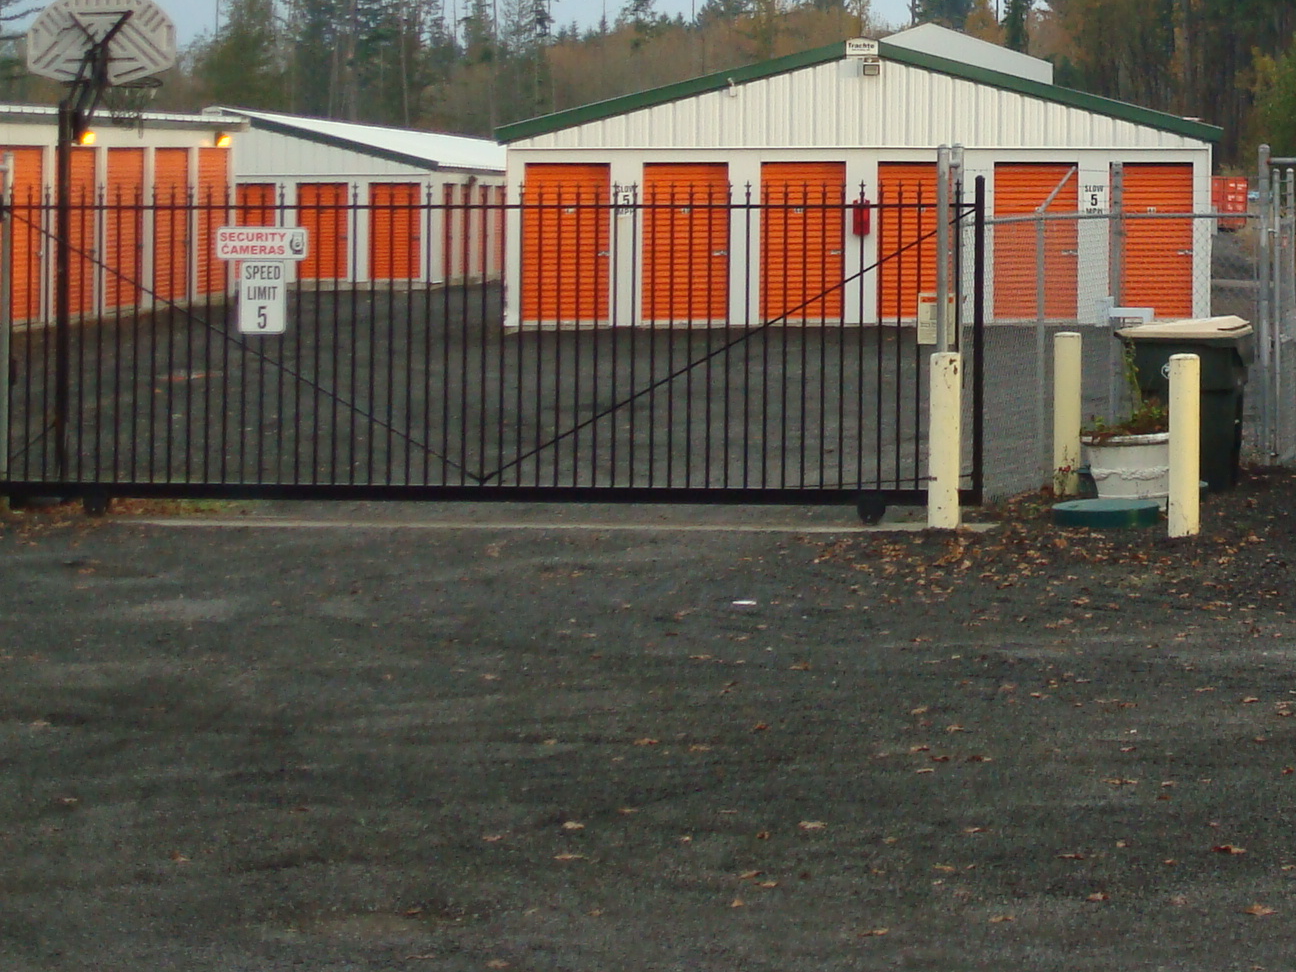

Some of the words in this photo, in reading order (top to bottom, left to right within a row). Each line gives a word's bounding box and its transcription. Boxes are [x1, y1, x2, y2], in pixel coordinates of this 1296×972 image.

[1085, 184, 1104, 192] SLOW
[623, 194, 630, 206] 5
[1090, 194, 1098, 206] 5
[220, 232, 287, 242] SECURITY
[221, 245, 285, 255] CAMERAS
[245, 265, 281, 280] SPEED
[247, 286, 278, 300] LIMIT
[257, 306, 267, 329] 5
